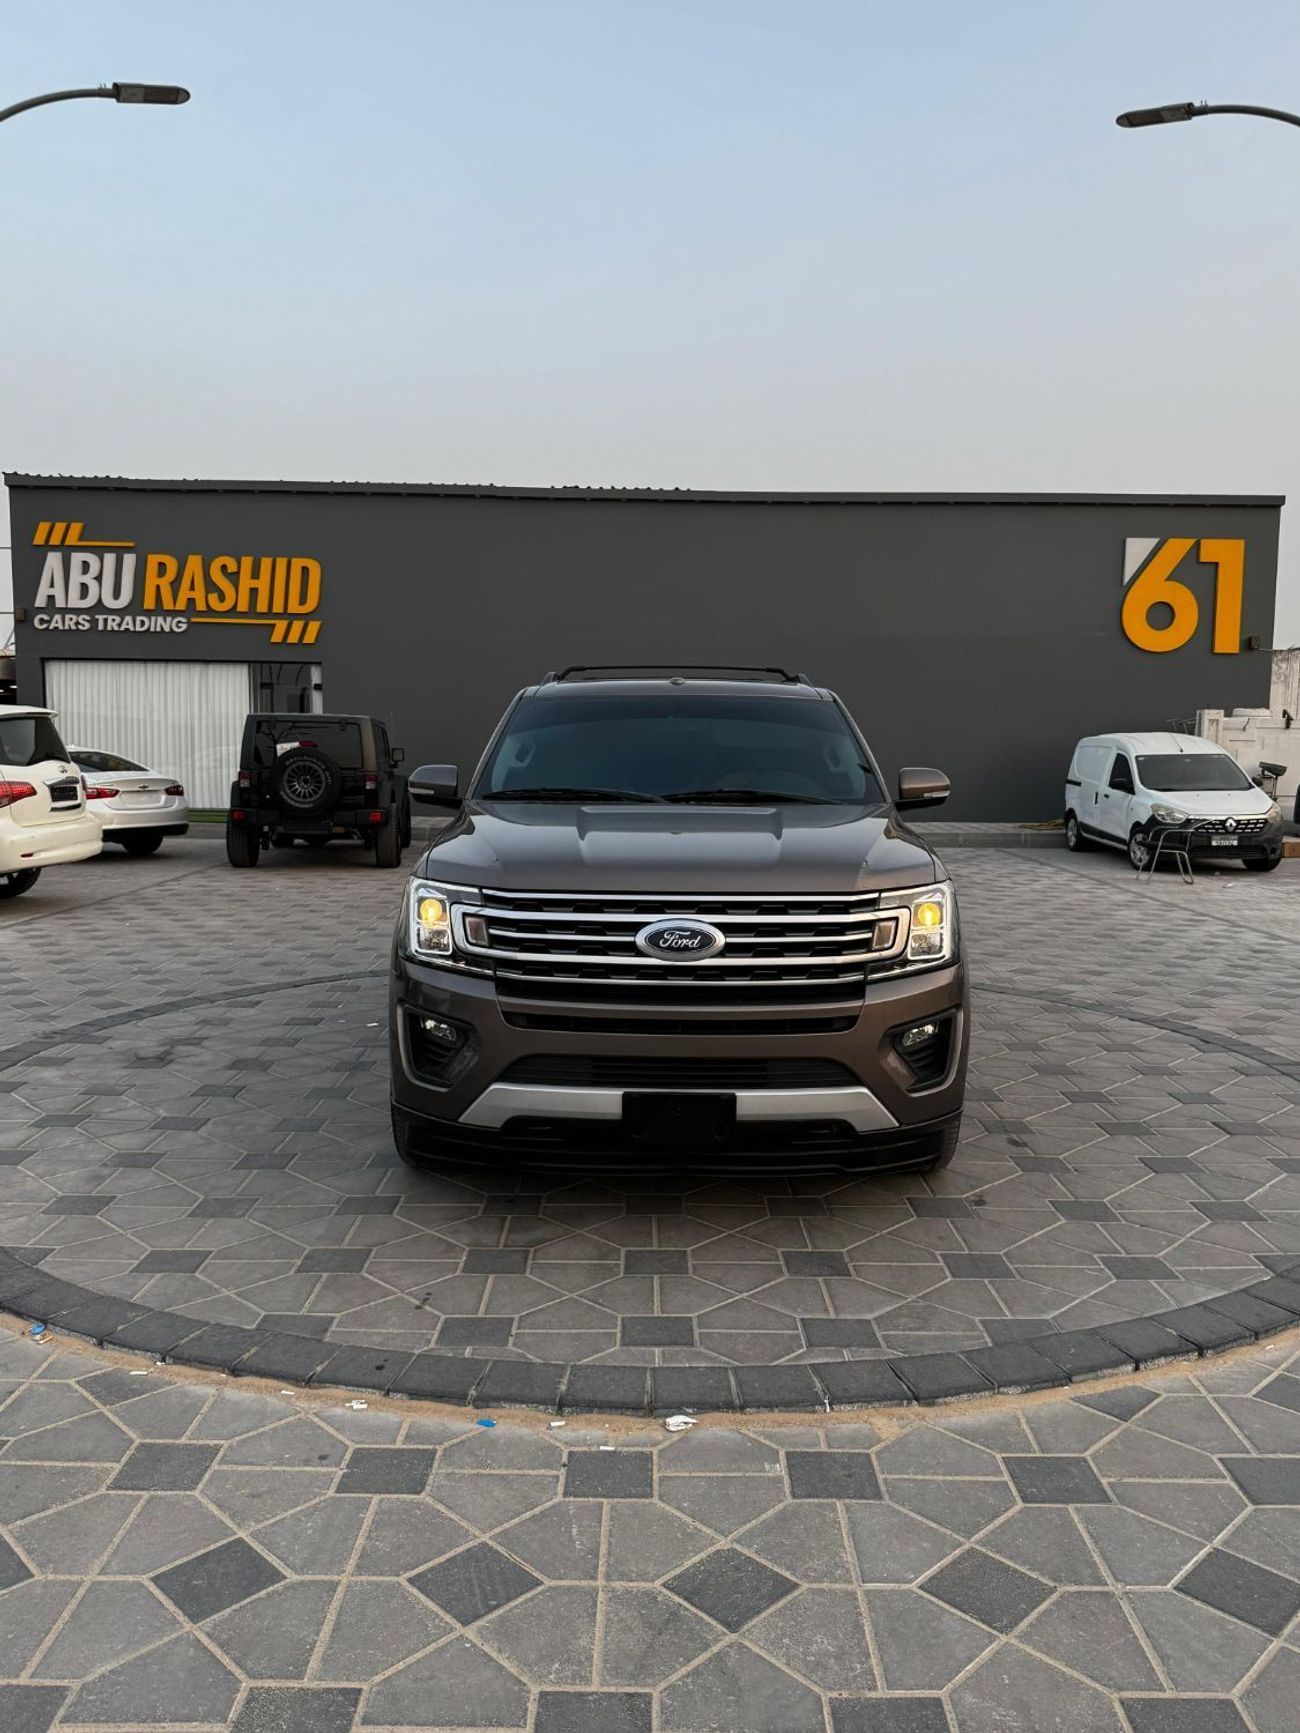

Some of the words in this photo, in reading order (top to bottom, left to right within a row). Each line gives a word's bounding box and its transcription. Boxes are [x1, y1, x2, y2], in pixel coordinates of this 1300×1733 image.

[34, 551, 136, 609] ABU
[143, 553, 321, 614] RASHID
[1121, 537, 1245, 653] 61
[33, 614, 91, 631] CARS
[95, 614, 188, 633] TRADING
[659, 930, 702, 948] Ford
